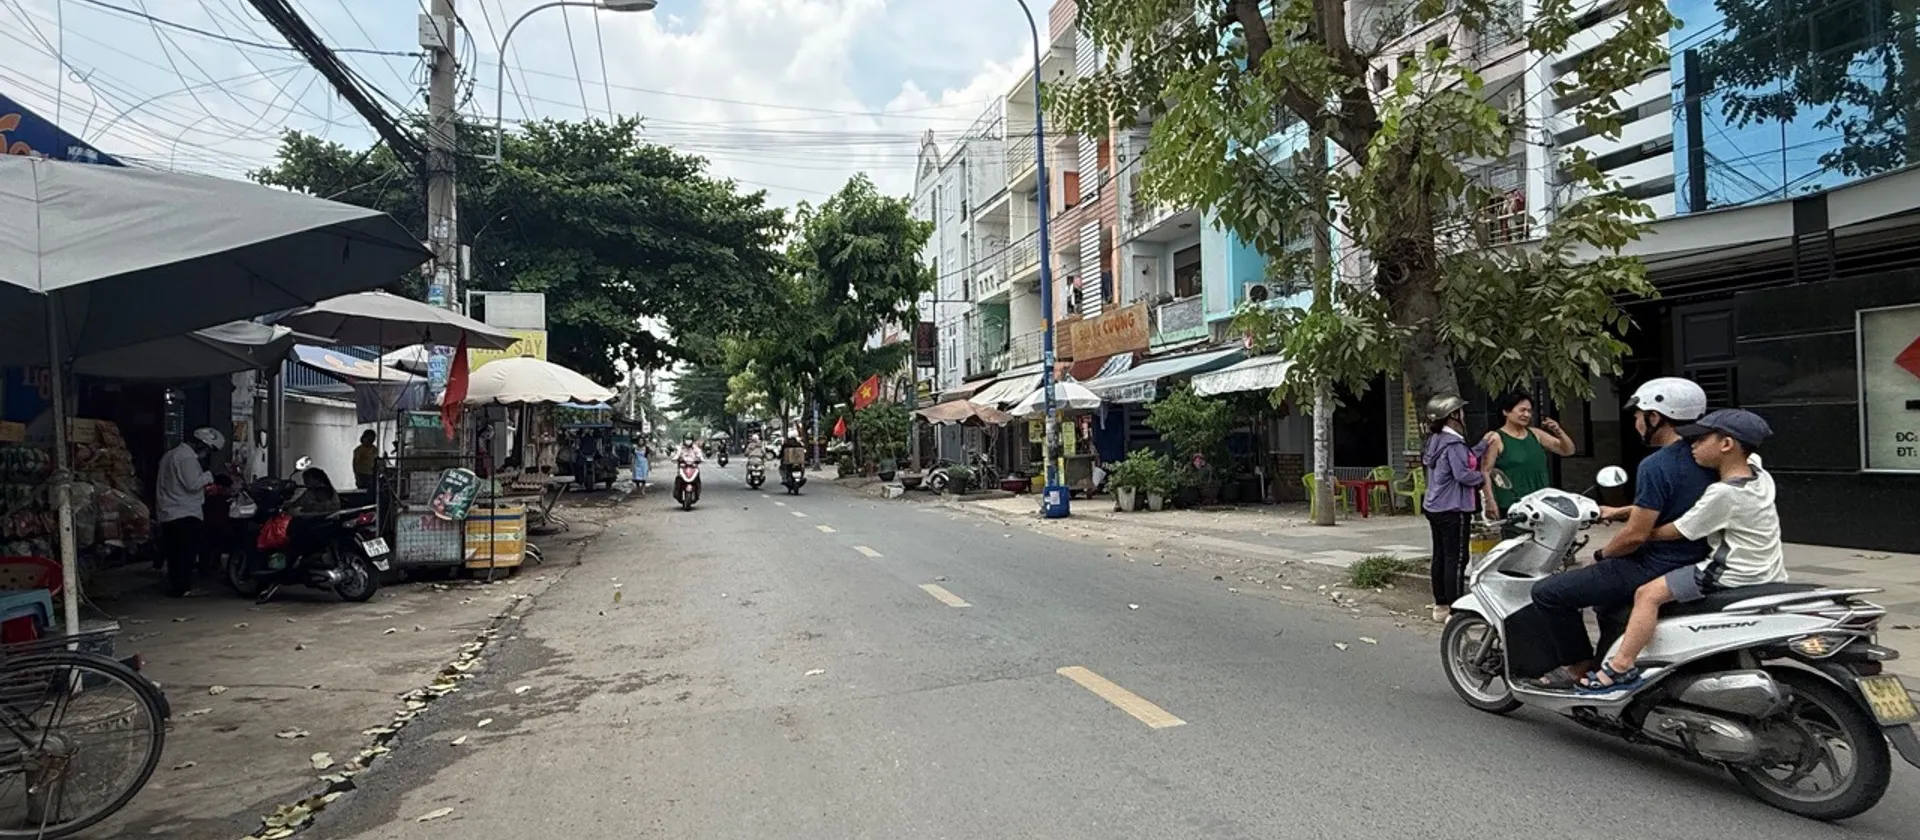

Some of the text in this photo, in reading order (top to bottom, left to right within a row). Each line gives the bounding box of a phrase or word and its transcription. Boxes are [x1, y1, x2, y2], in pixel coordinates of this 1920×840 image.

[1895, 431, 1918, 442] ĐC:
[1896, 446, 1918, 457] ĐT:
[1687, 620, 1762, 632] VISION
